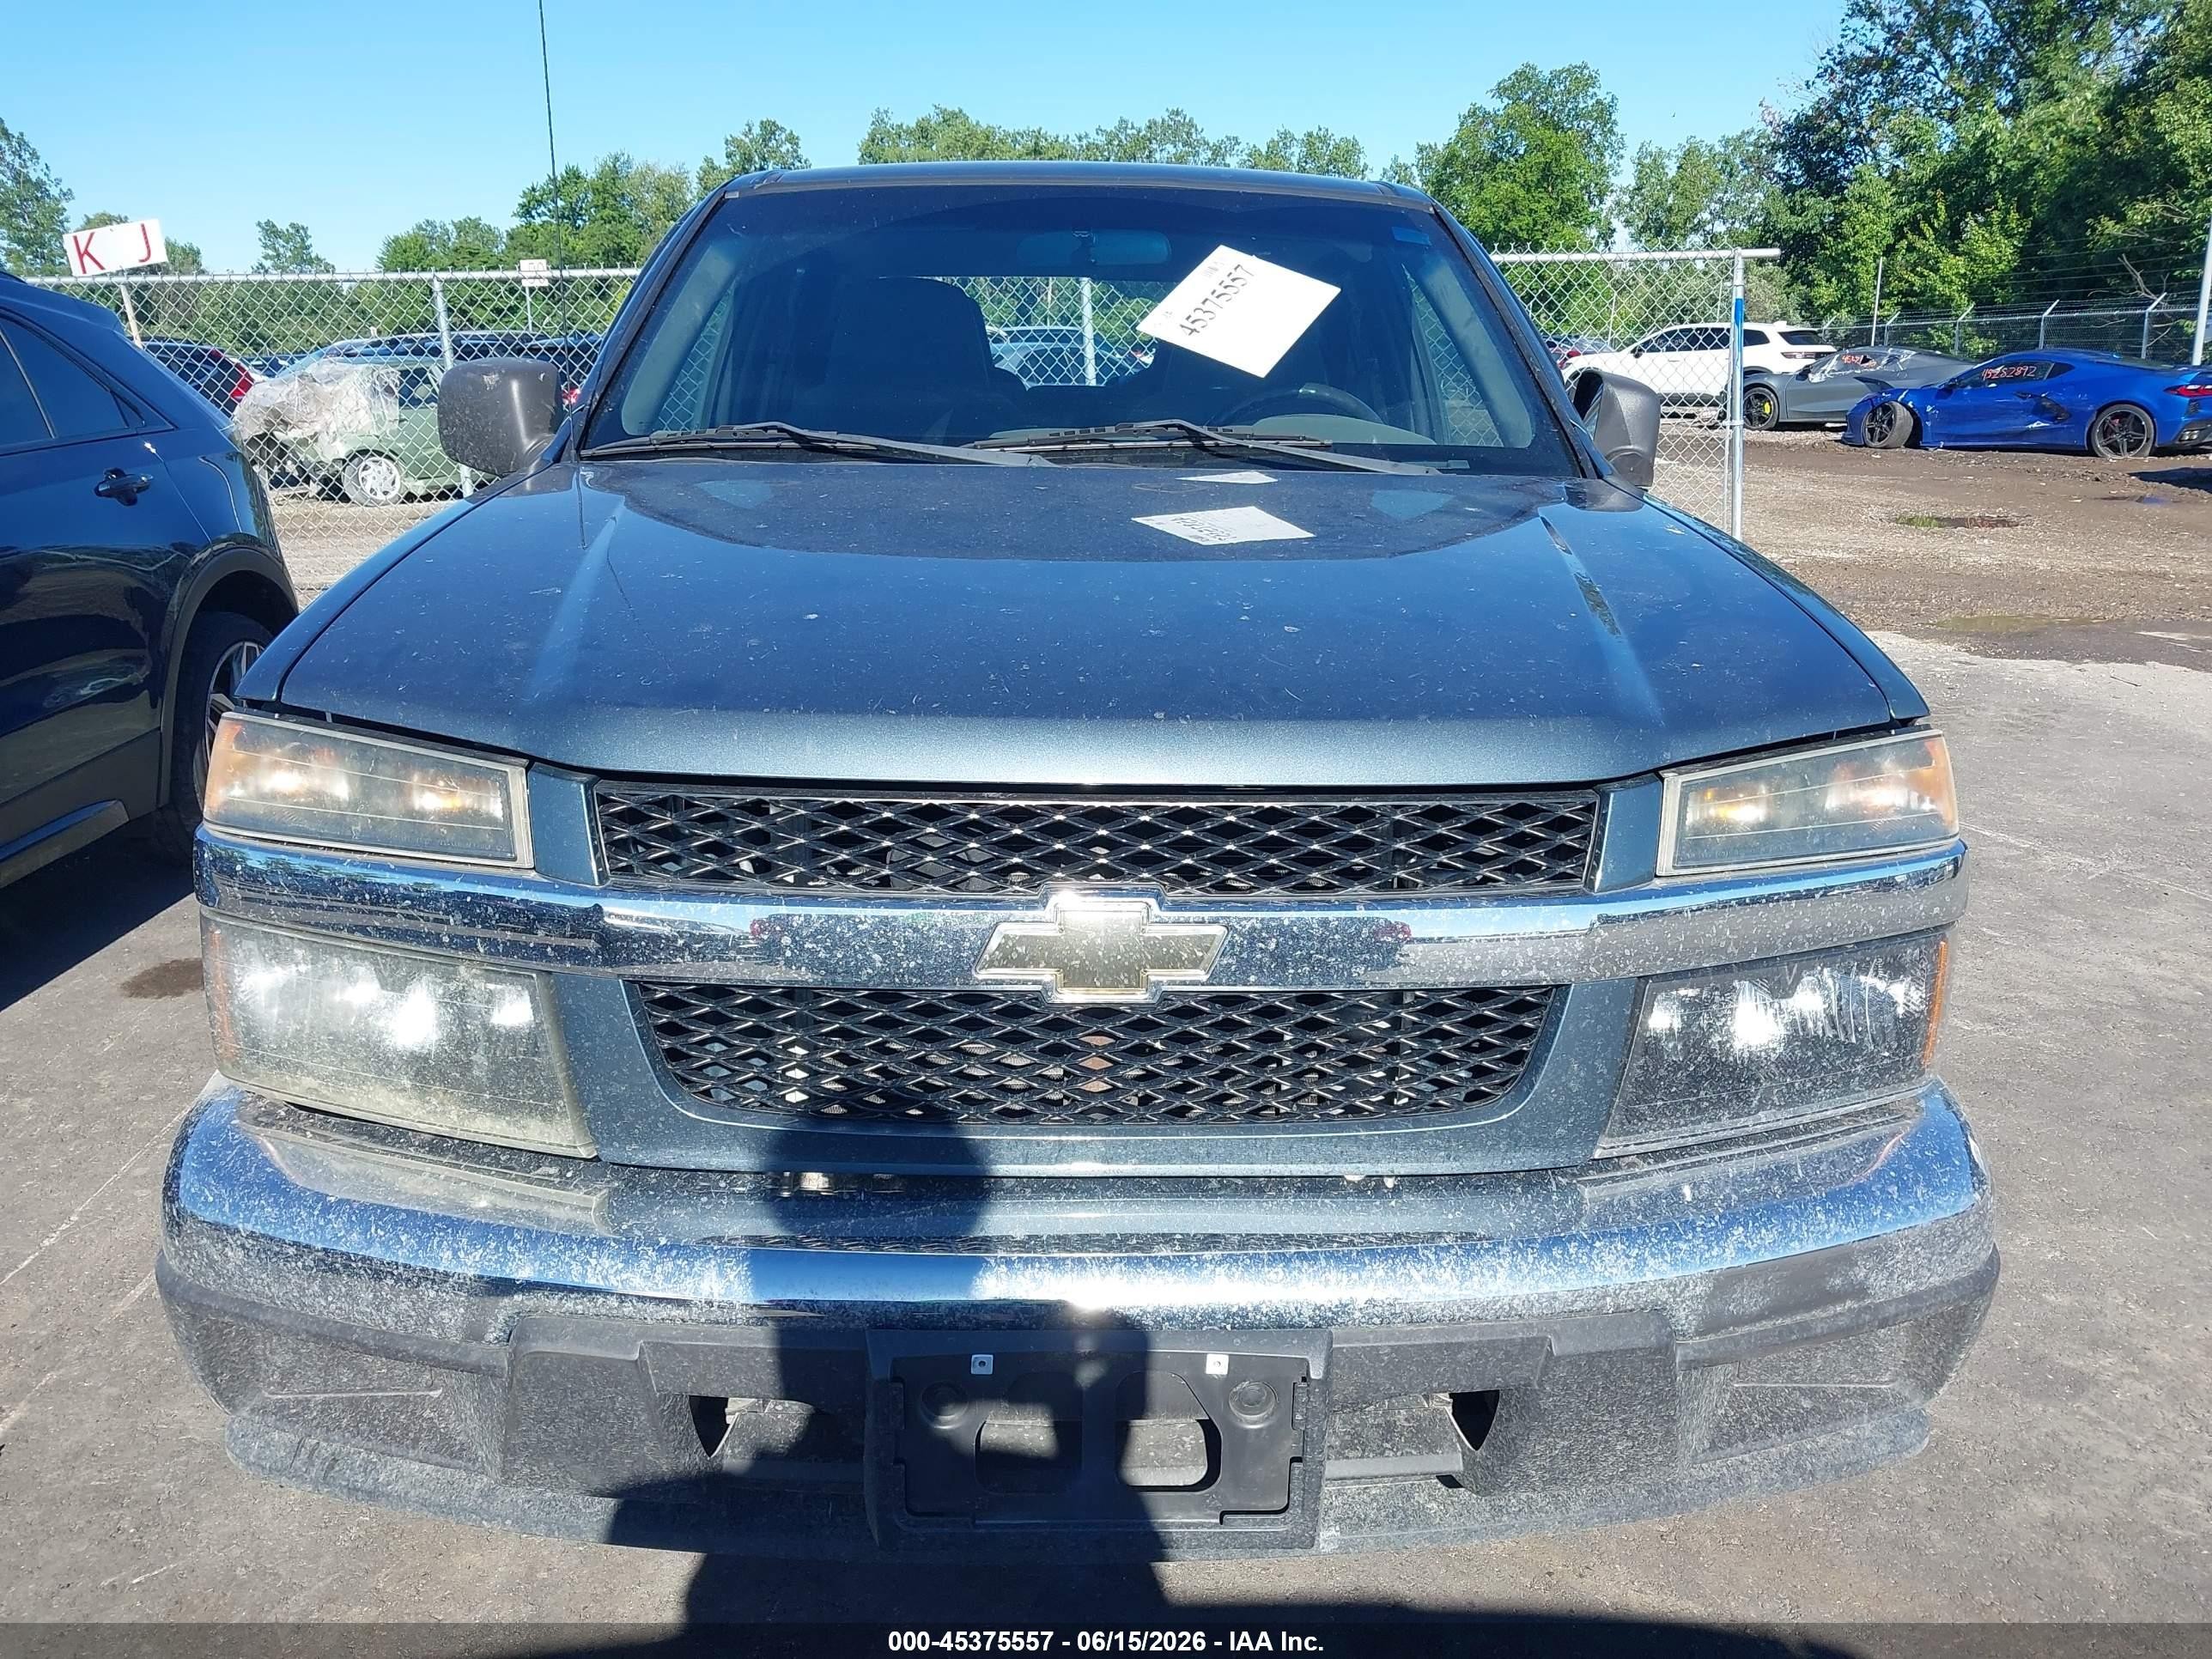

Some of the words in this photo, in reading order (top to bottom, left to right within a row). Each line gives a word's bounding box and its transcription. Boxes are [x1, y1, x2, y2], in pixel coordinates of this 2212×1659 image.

[72, 232, 106, 275] K
[138, 223, 152, 263] J
[1179, 264, 1255, 336] 45375557
